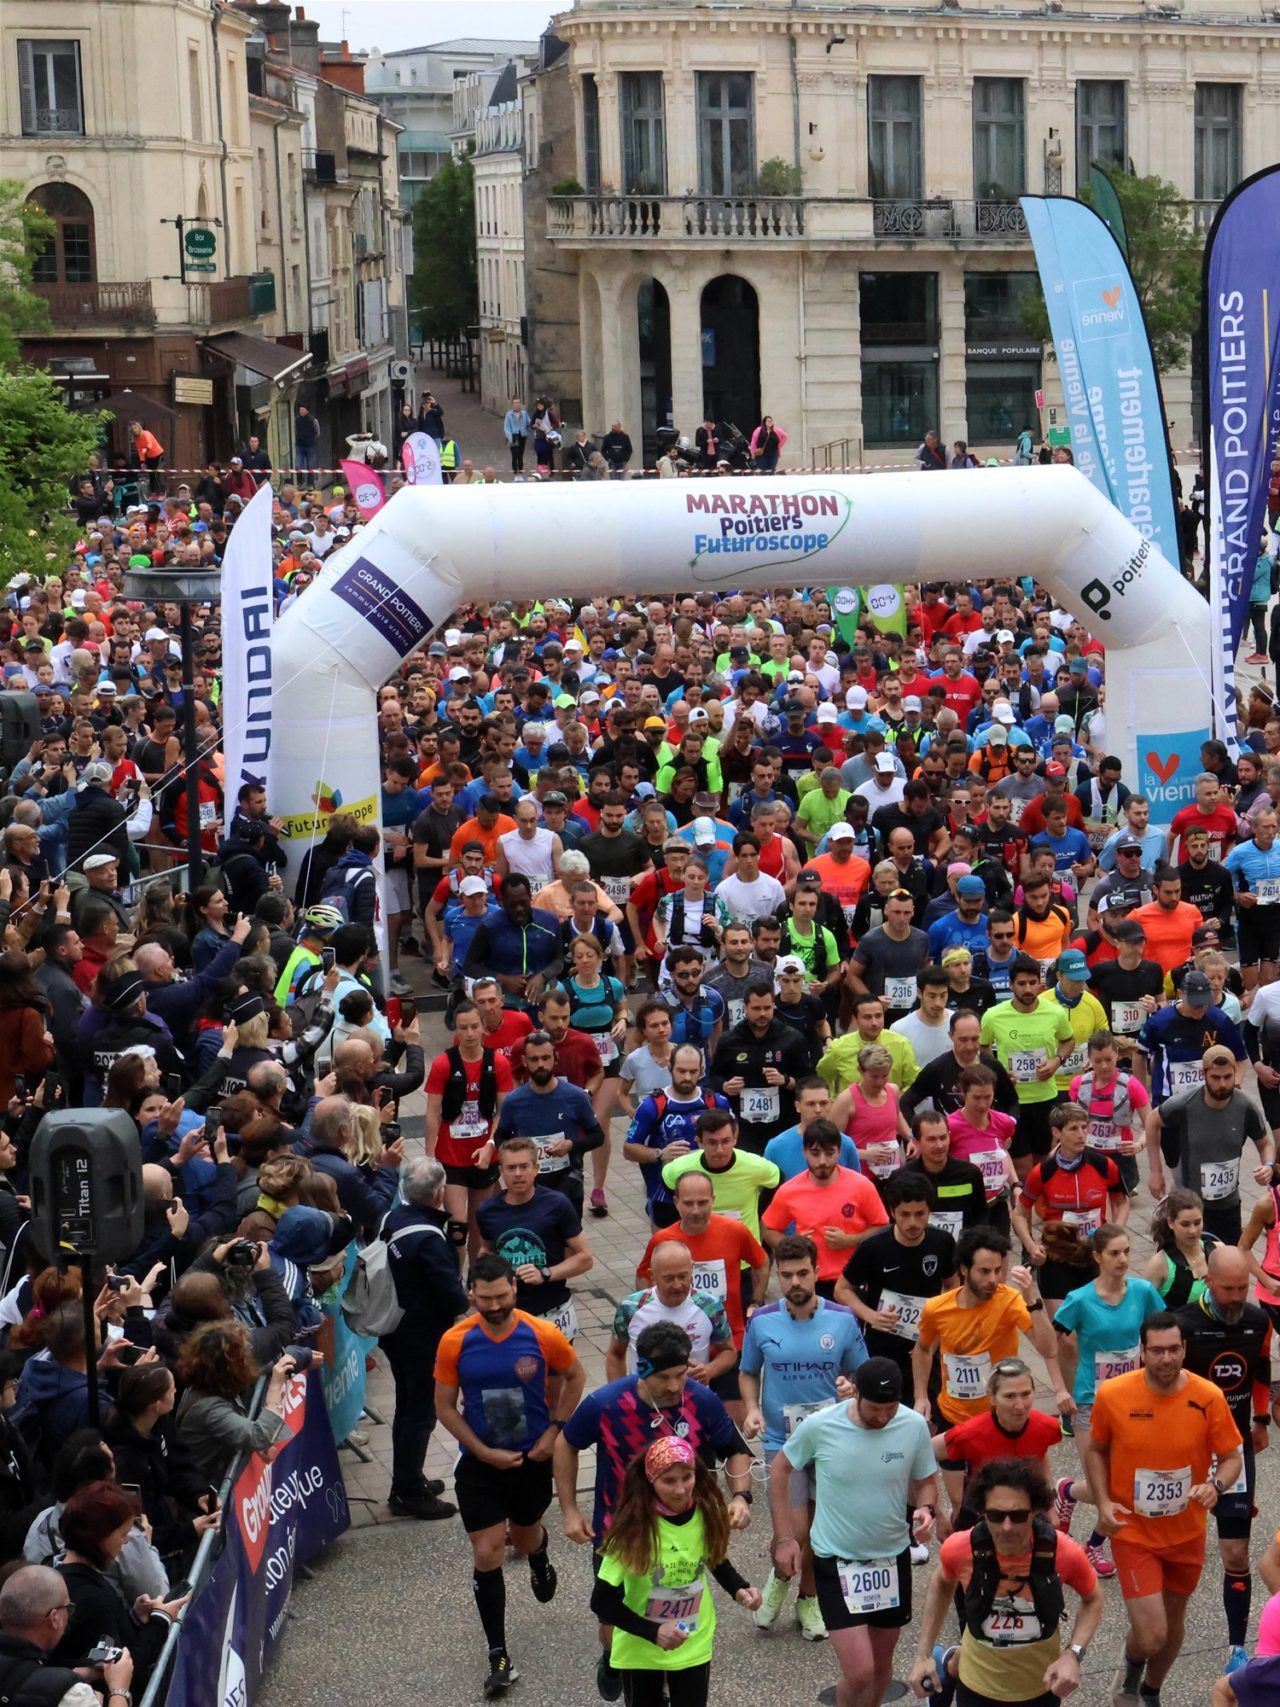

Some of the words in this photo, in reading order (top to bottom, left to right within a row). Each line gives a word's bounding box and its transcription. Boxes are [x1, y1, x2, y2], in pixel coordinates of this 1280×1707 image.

[195, 231, 204, 241] Bar
[967, 347, 997, 355] BANQUE
[1219, 290, 1249, 458] POITIERS
[686, 494, 839, 516] MARATHON
[720, 514, 803, 537] Poitiers
[695, 533, 829, 554] Futuroscope
[357, 569, 392, 600] GRAND
[389, 596, 424, 634] POITIERS
[1144, 773, 1155, 786] la
[1262, 886, 1280, 897] 2614
[892, 987, 912, 998] 2316
[1123, 1010, 1139, 1022] 310
[749, 1097, 773, 1112] 2481
[76, 1158, 88, 1172] 12
[980, 1155, 1004, 1170] 2573
[1209, 1171, 1234, 1187] 2435
[79, 1180, 90, 1216] Titan
[771, 1361, 835, 1372] ETIHAD
[782, 1373, 824, 1381] AIRWAYS
[955, 1367, 980, 1384] 2111
[1146, 1482, 1183, 1501] 2353
[852, 1568, 890, 1595] 2600
[660, 1597, 695, 1619] 2477
